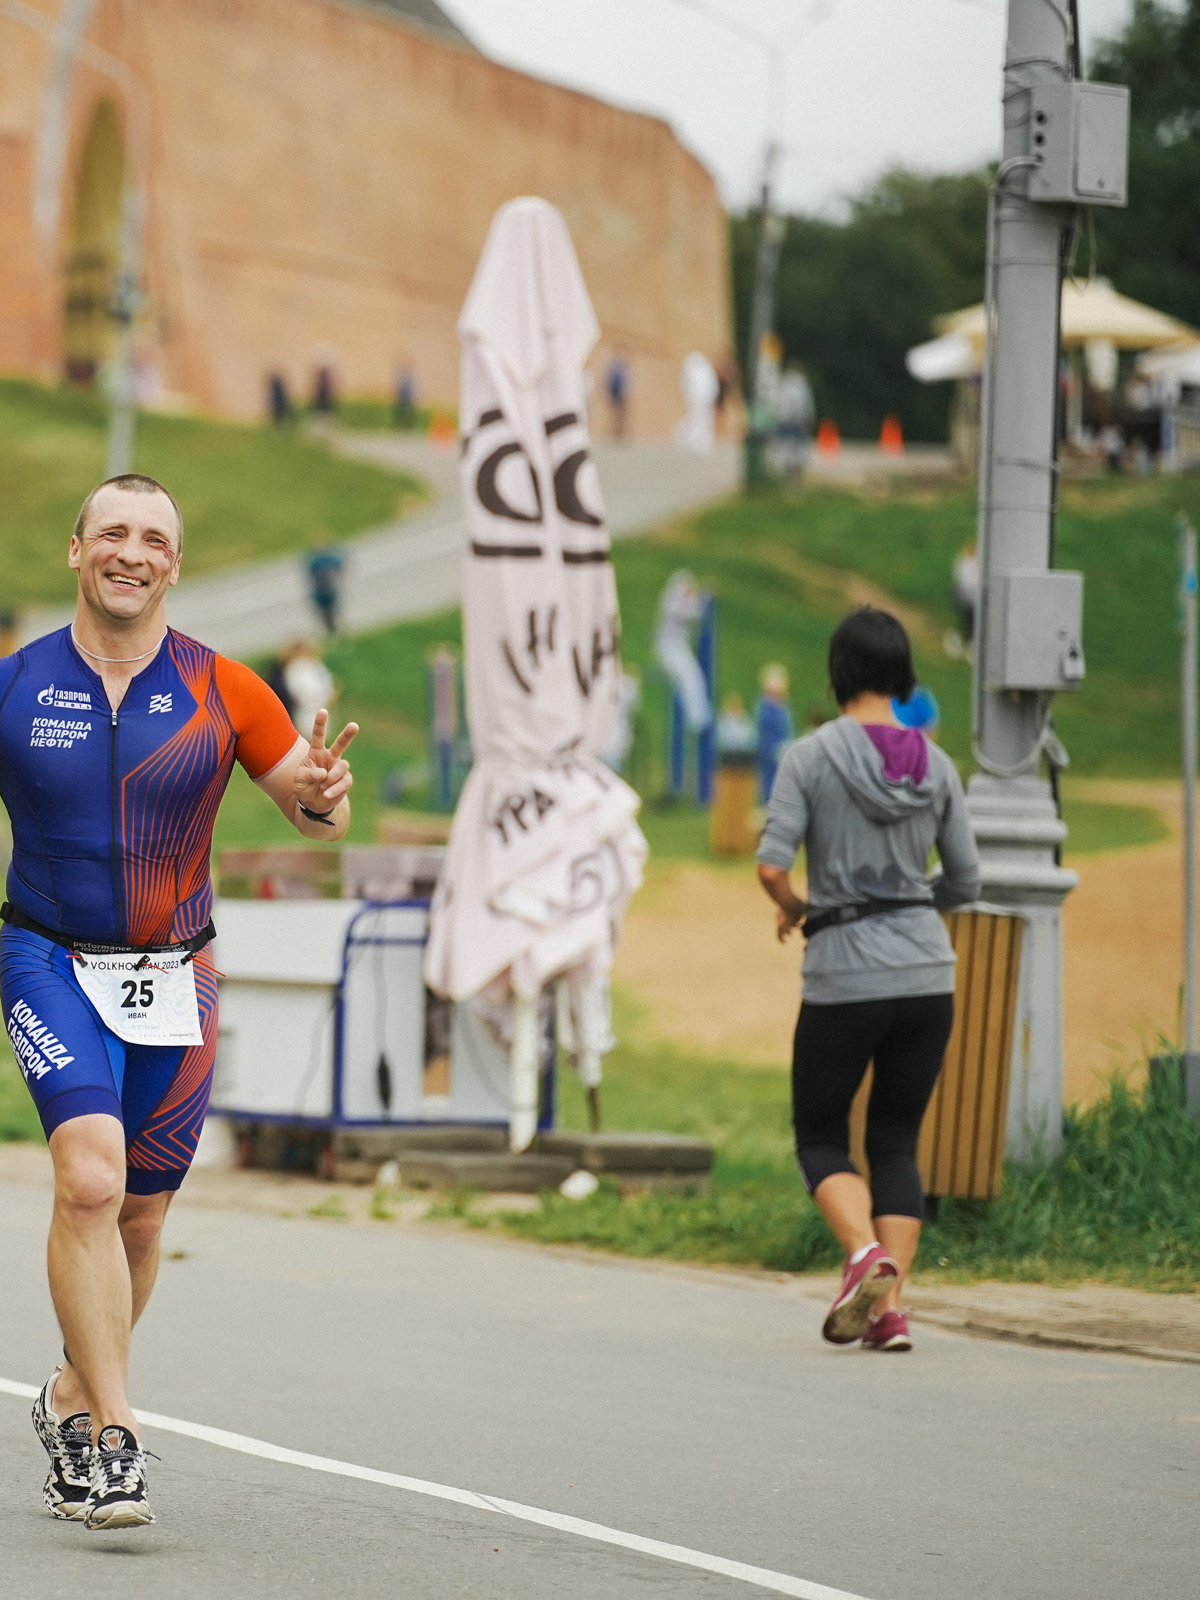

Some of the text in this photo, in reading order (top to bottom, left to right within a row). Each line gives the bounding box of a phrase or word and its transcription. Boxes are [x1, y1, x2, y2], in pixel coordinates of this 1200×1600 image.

[55, 690, 91, 703] ГАЗПРОМ
[32, 717, 92, 731] КОМАНДА
[31, 727, 88, 740] ГАЗПРОМ
[30, 737, 73, 749] НЕФТИ
[73, 941, 132, 952] performance
[90, 961, 179, 971] VOLKHOMAN 2023
[120, 980, 154, 1008] 25
[11, 999, 75, 1070] КОМАНДА
[7, 1017, 52, 1080] ГАЗПРОМ
